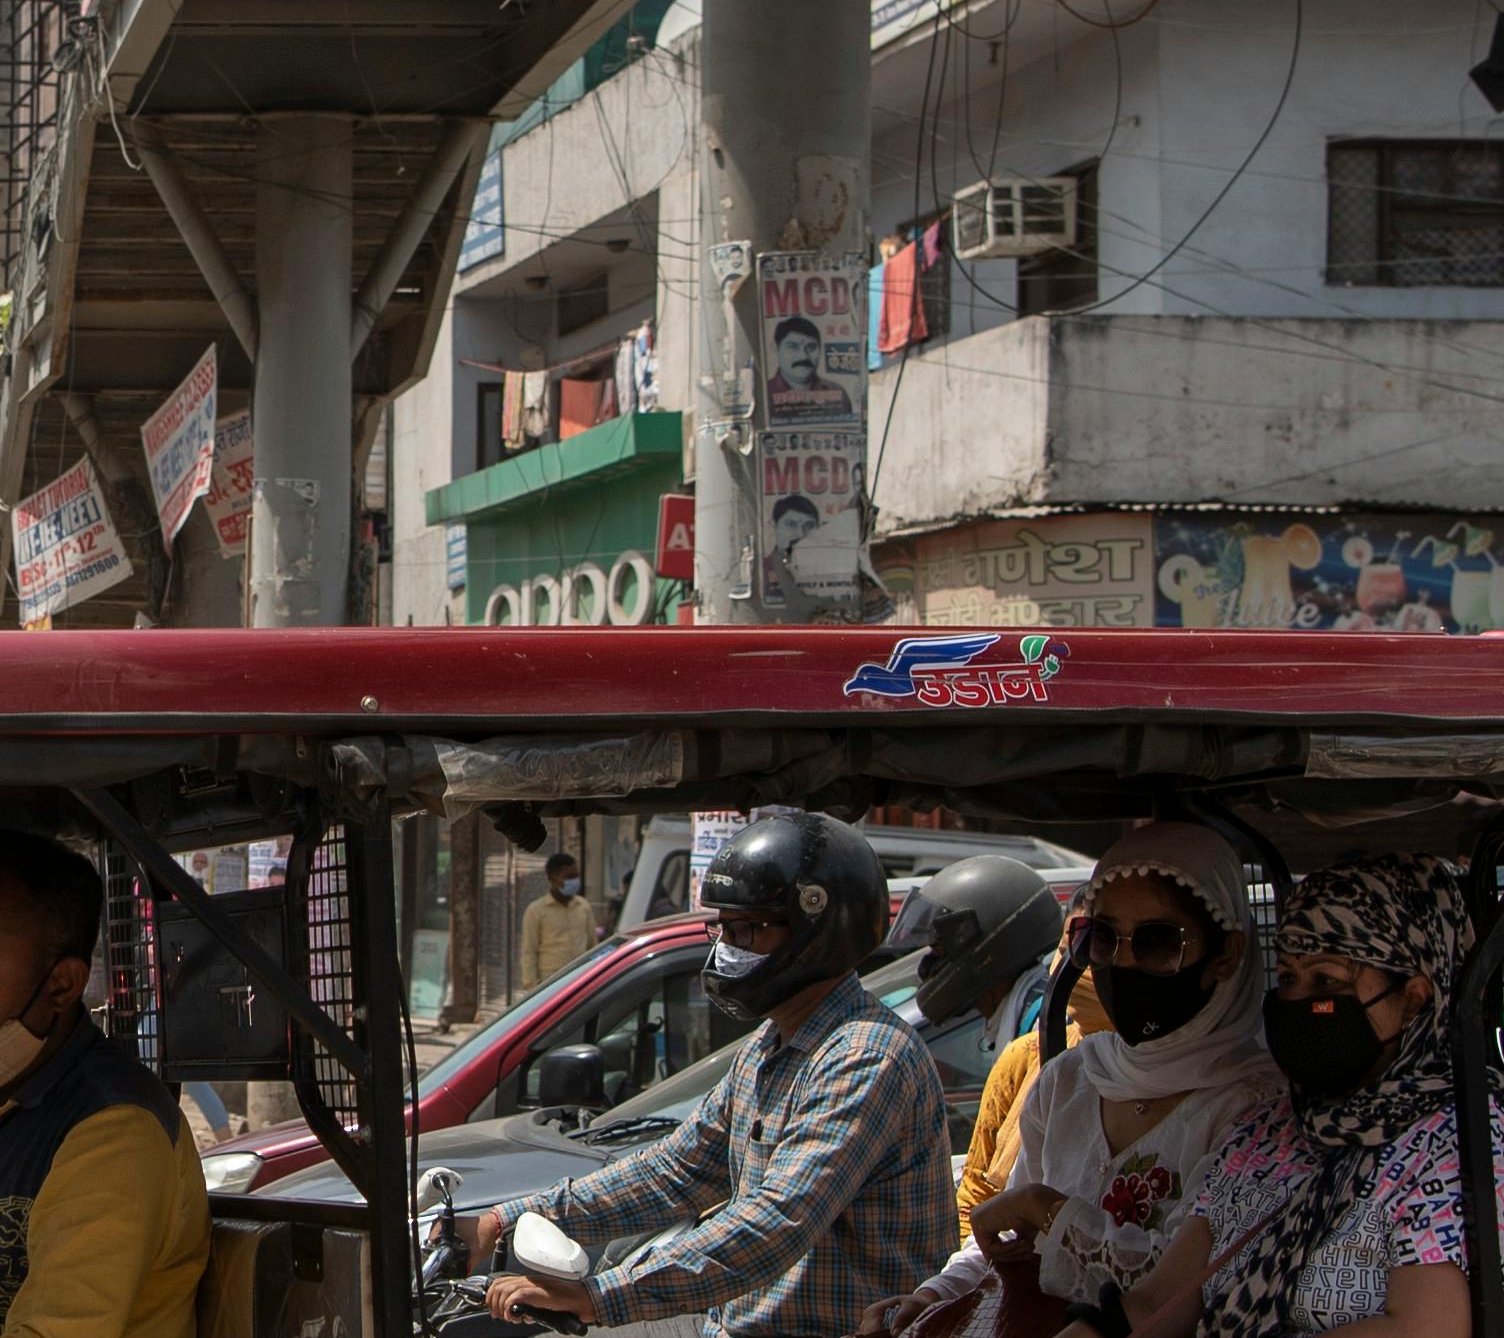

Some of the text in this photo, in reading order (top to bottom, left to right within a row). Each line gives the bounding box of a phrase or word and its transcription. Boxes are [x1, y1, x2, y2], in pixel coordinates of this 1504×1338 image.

[764, 277, 849, 319] MCD
[764, 455, 849, 497] MCD
[962, 528, 1143, 590] गणेश
[1214, 585, 1322, 629] Juice
